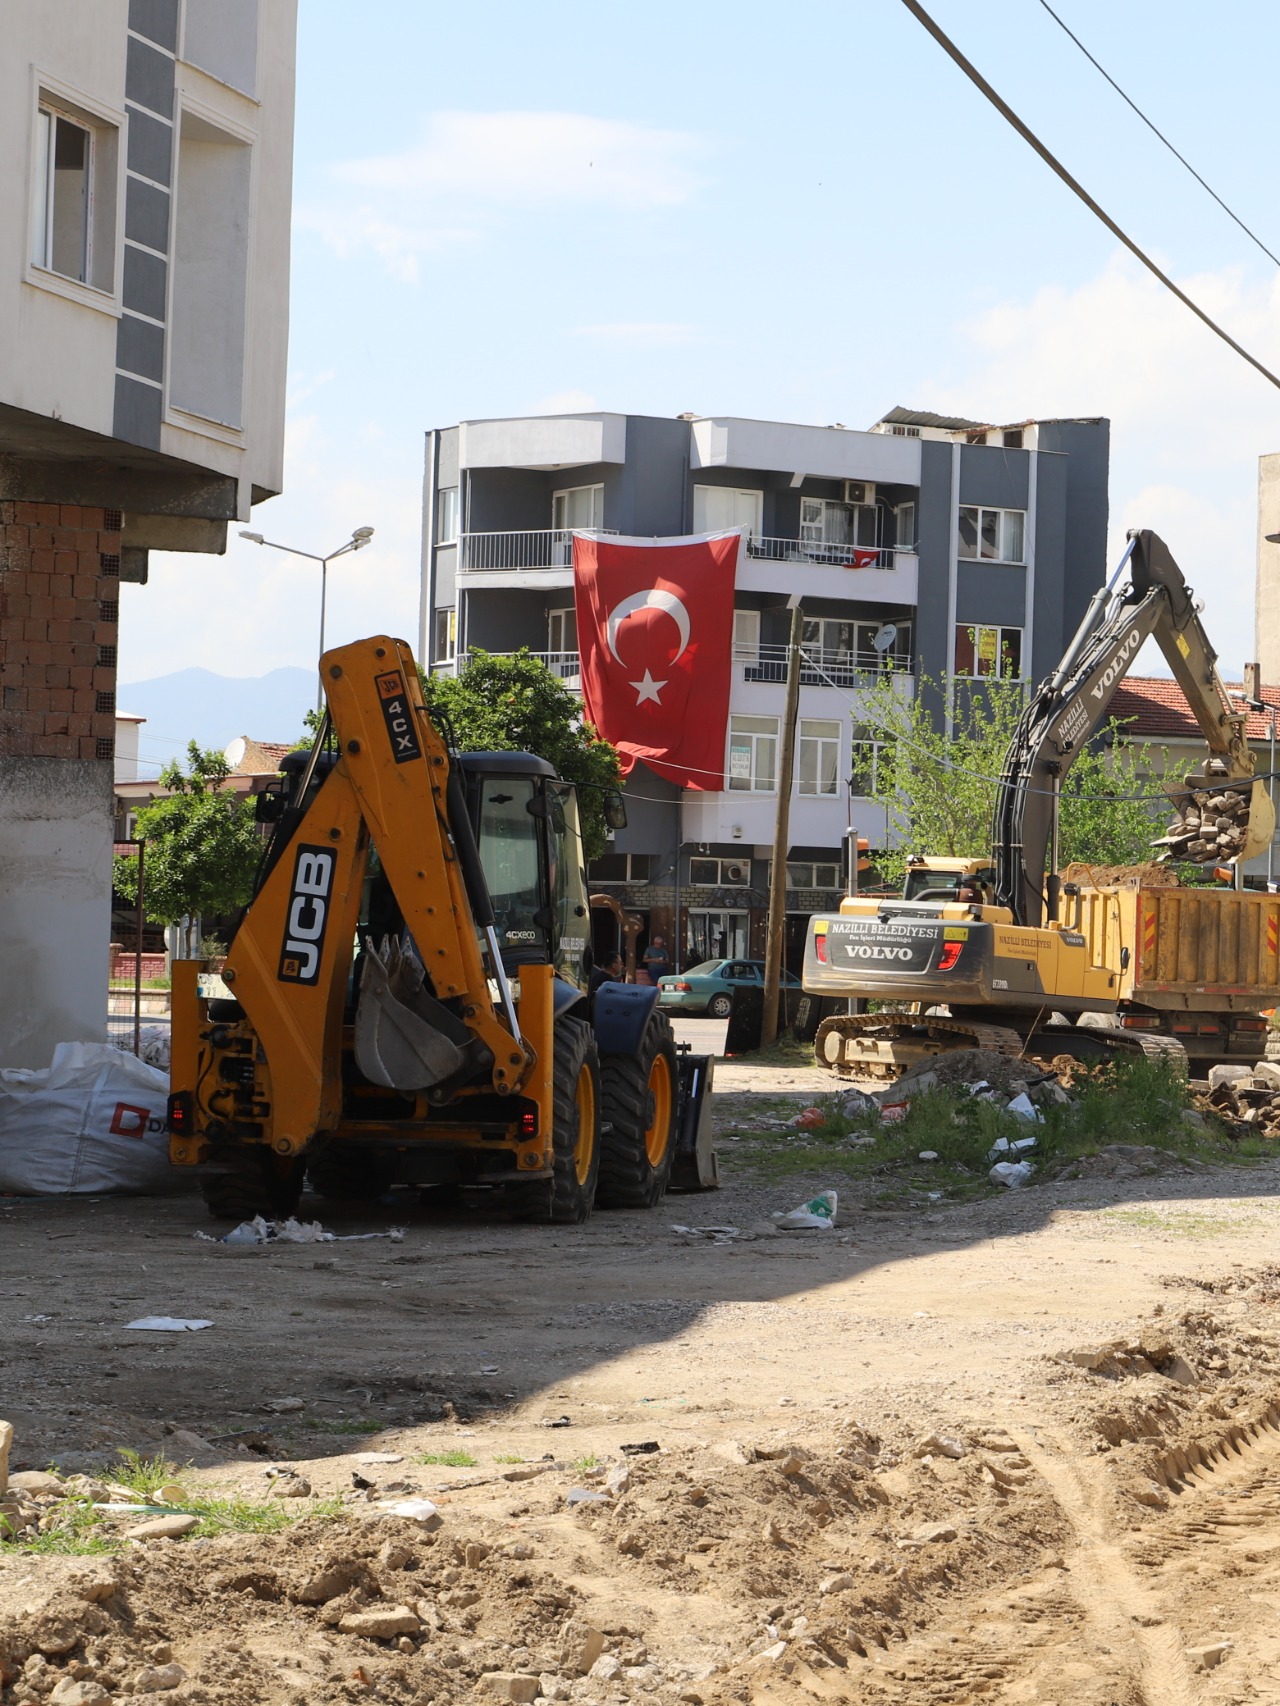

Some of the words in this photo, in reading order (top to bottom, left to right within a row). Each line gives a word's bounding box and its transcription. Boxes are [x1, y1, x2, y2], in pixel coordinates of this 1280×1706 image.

[1091, 629, 1140, 699] VOLVO
[388, 701, 413, 750] 4CX
[286, 852, 332, 979] JCB
[832, 923, 869, 934] NAZİLLİ
[871, 924, 939, 939] BELEDİYESİ
[845, 945, 913, 961] VOLVO
[1066, 936, 1083, 944] VOLVO
